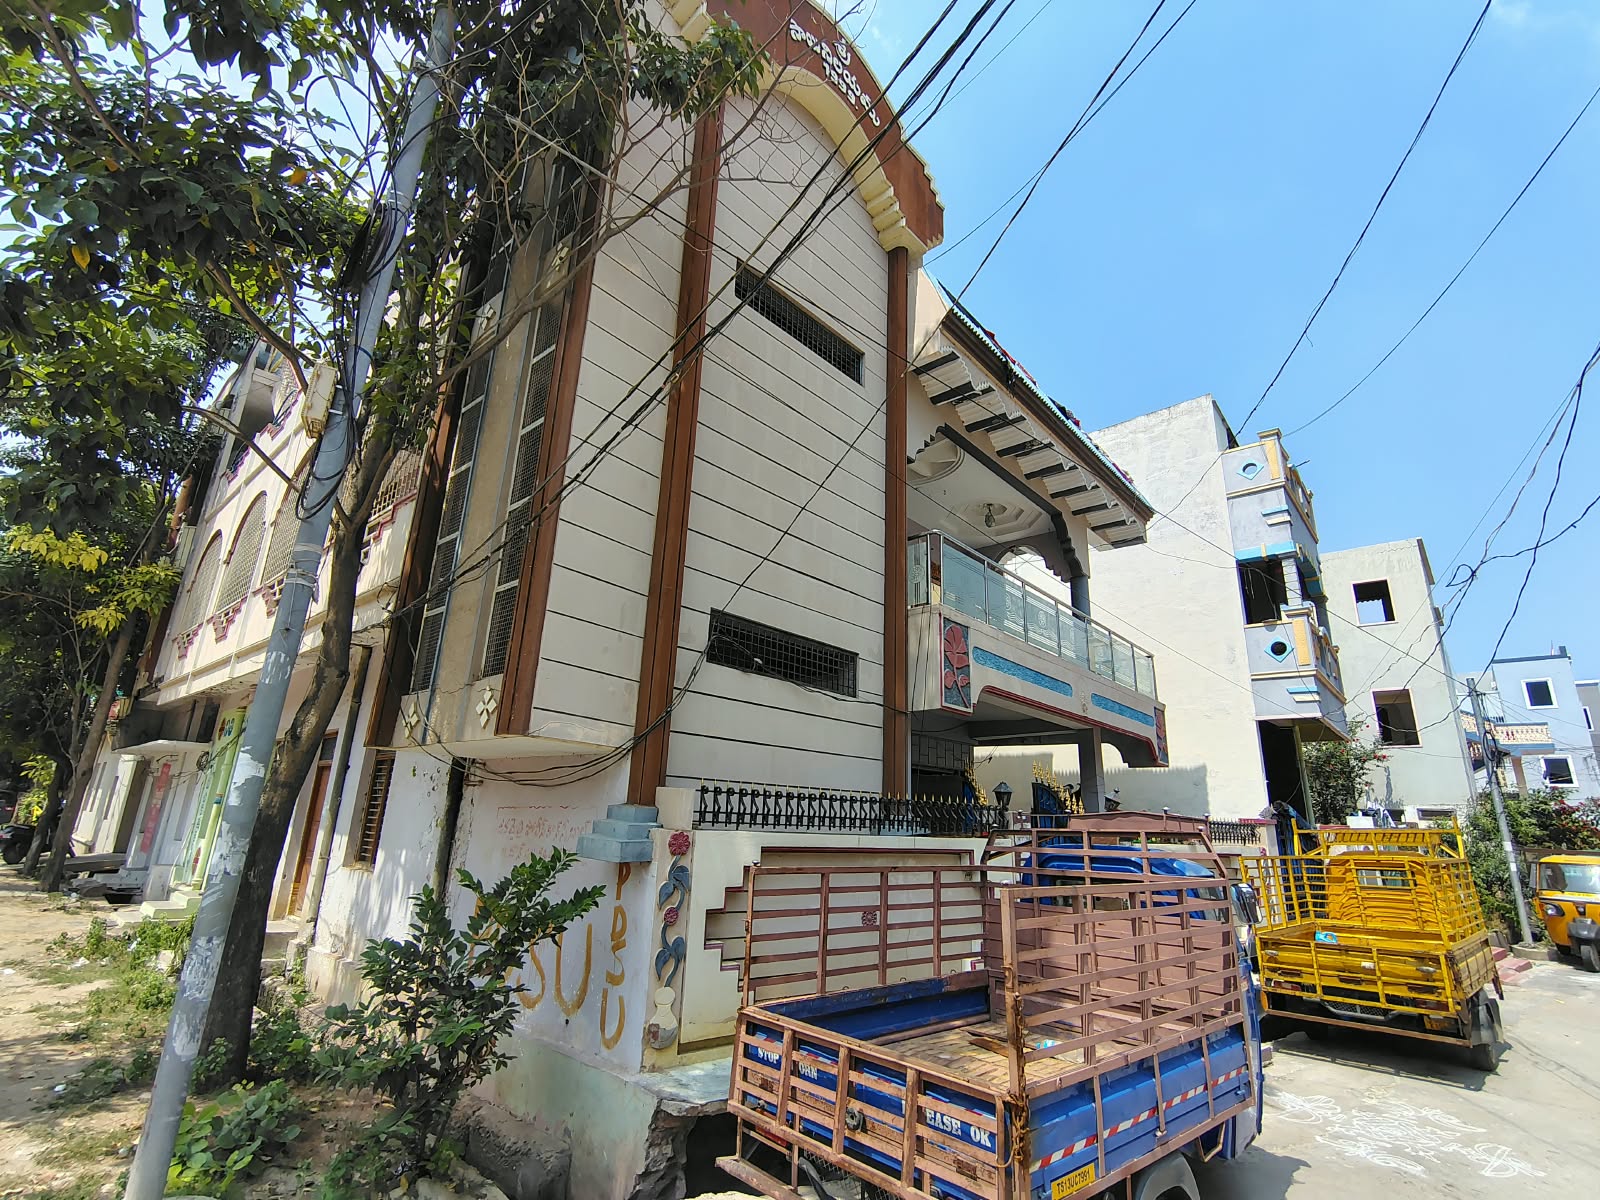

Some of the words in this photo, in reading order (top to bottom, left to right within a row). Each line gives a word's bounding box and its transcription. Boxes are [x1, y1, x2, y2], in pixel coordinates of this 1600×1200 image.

[758, 1047, 780, 1064] STOP
[791, 1060, 818, 1080] ORN
[970, 1125, 992, 1148] OK
